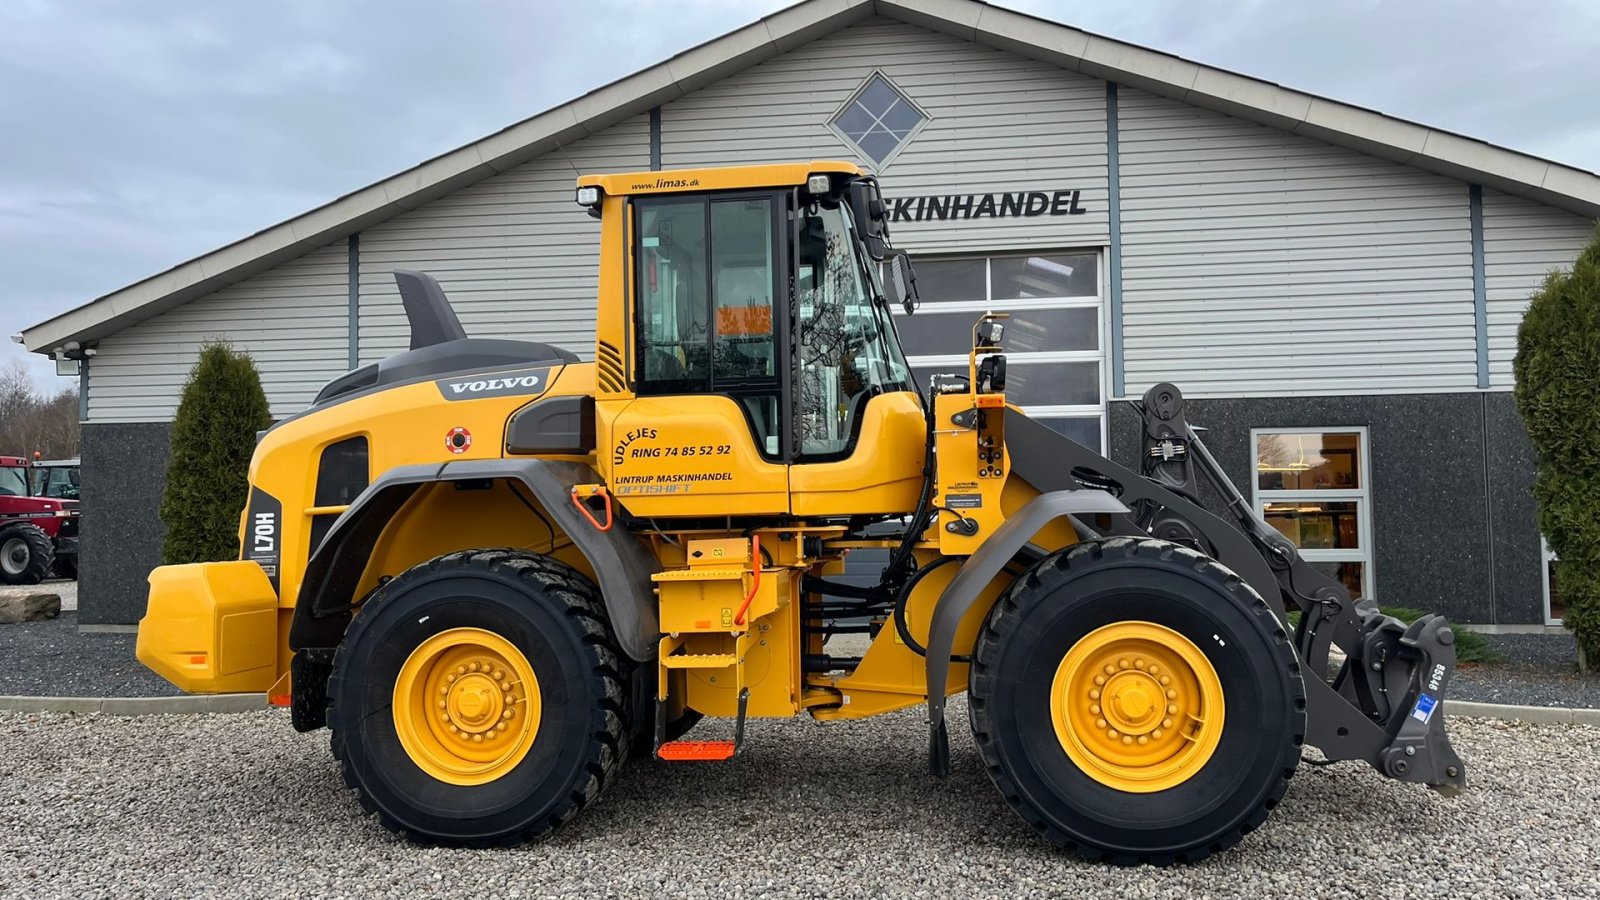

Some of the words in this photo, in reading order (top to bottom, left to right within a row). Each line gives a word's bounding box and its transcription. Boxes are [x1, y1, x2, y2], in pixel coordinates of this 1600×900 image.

[631, 179, 700, 190] www.limas.dk
[449, 376, 539, 393] VOLVO
[614, 428, 658, 465] UDLEJES
[631, 448, 661, 458] RING
[664, 447, 678, 457] 74
[681, 446, 696, 456] 85
[699, 445, 713, 455] 52
[716, 445, 731, 455] 92
[615, 475, 654, 484] LINTRUP
[656, 473, 733, 483] MASKINHANDEL
[617, 484, 692, 494] OPTISHIFT
[254, 512, 275, 552] L70H
